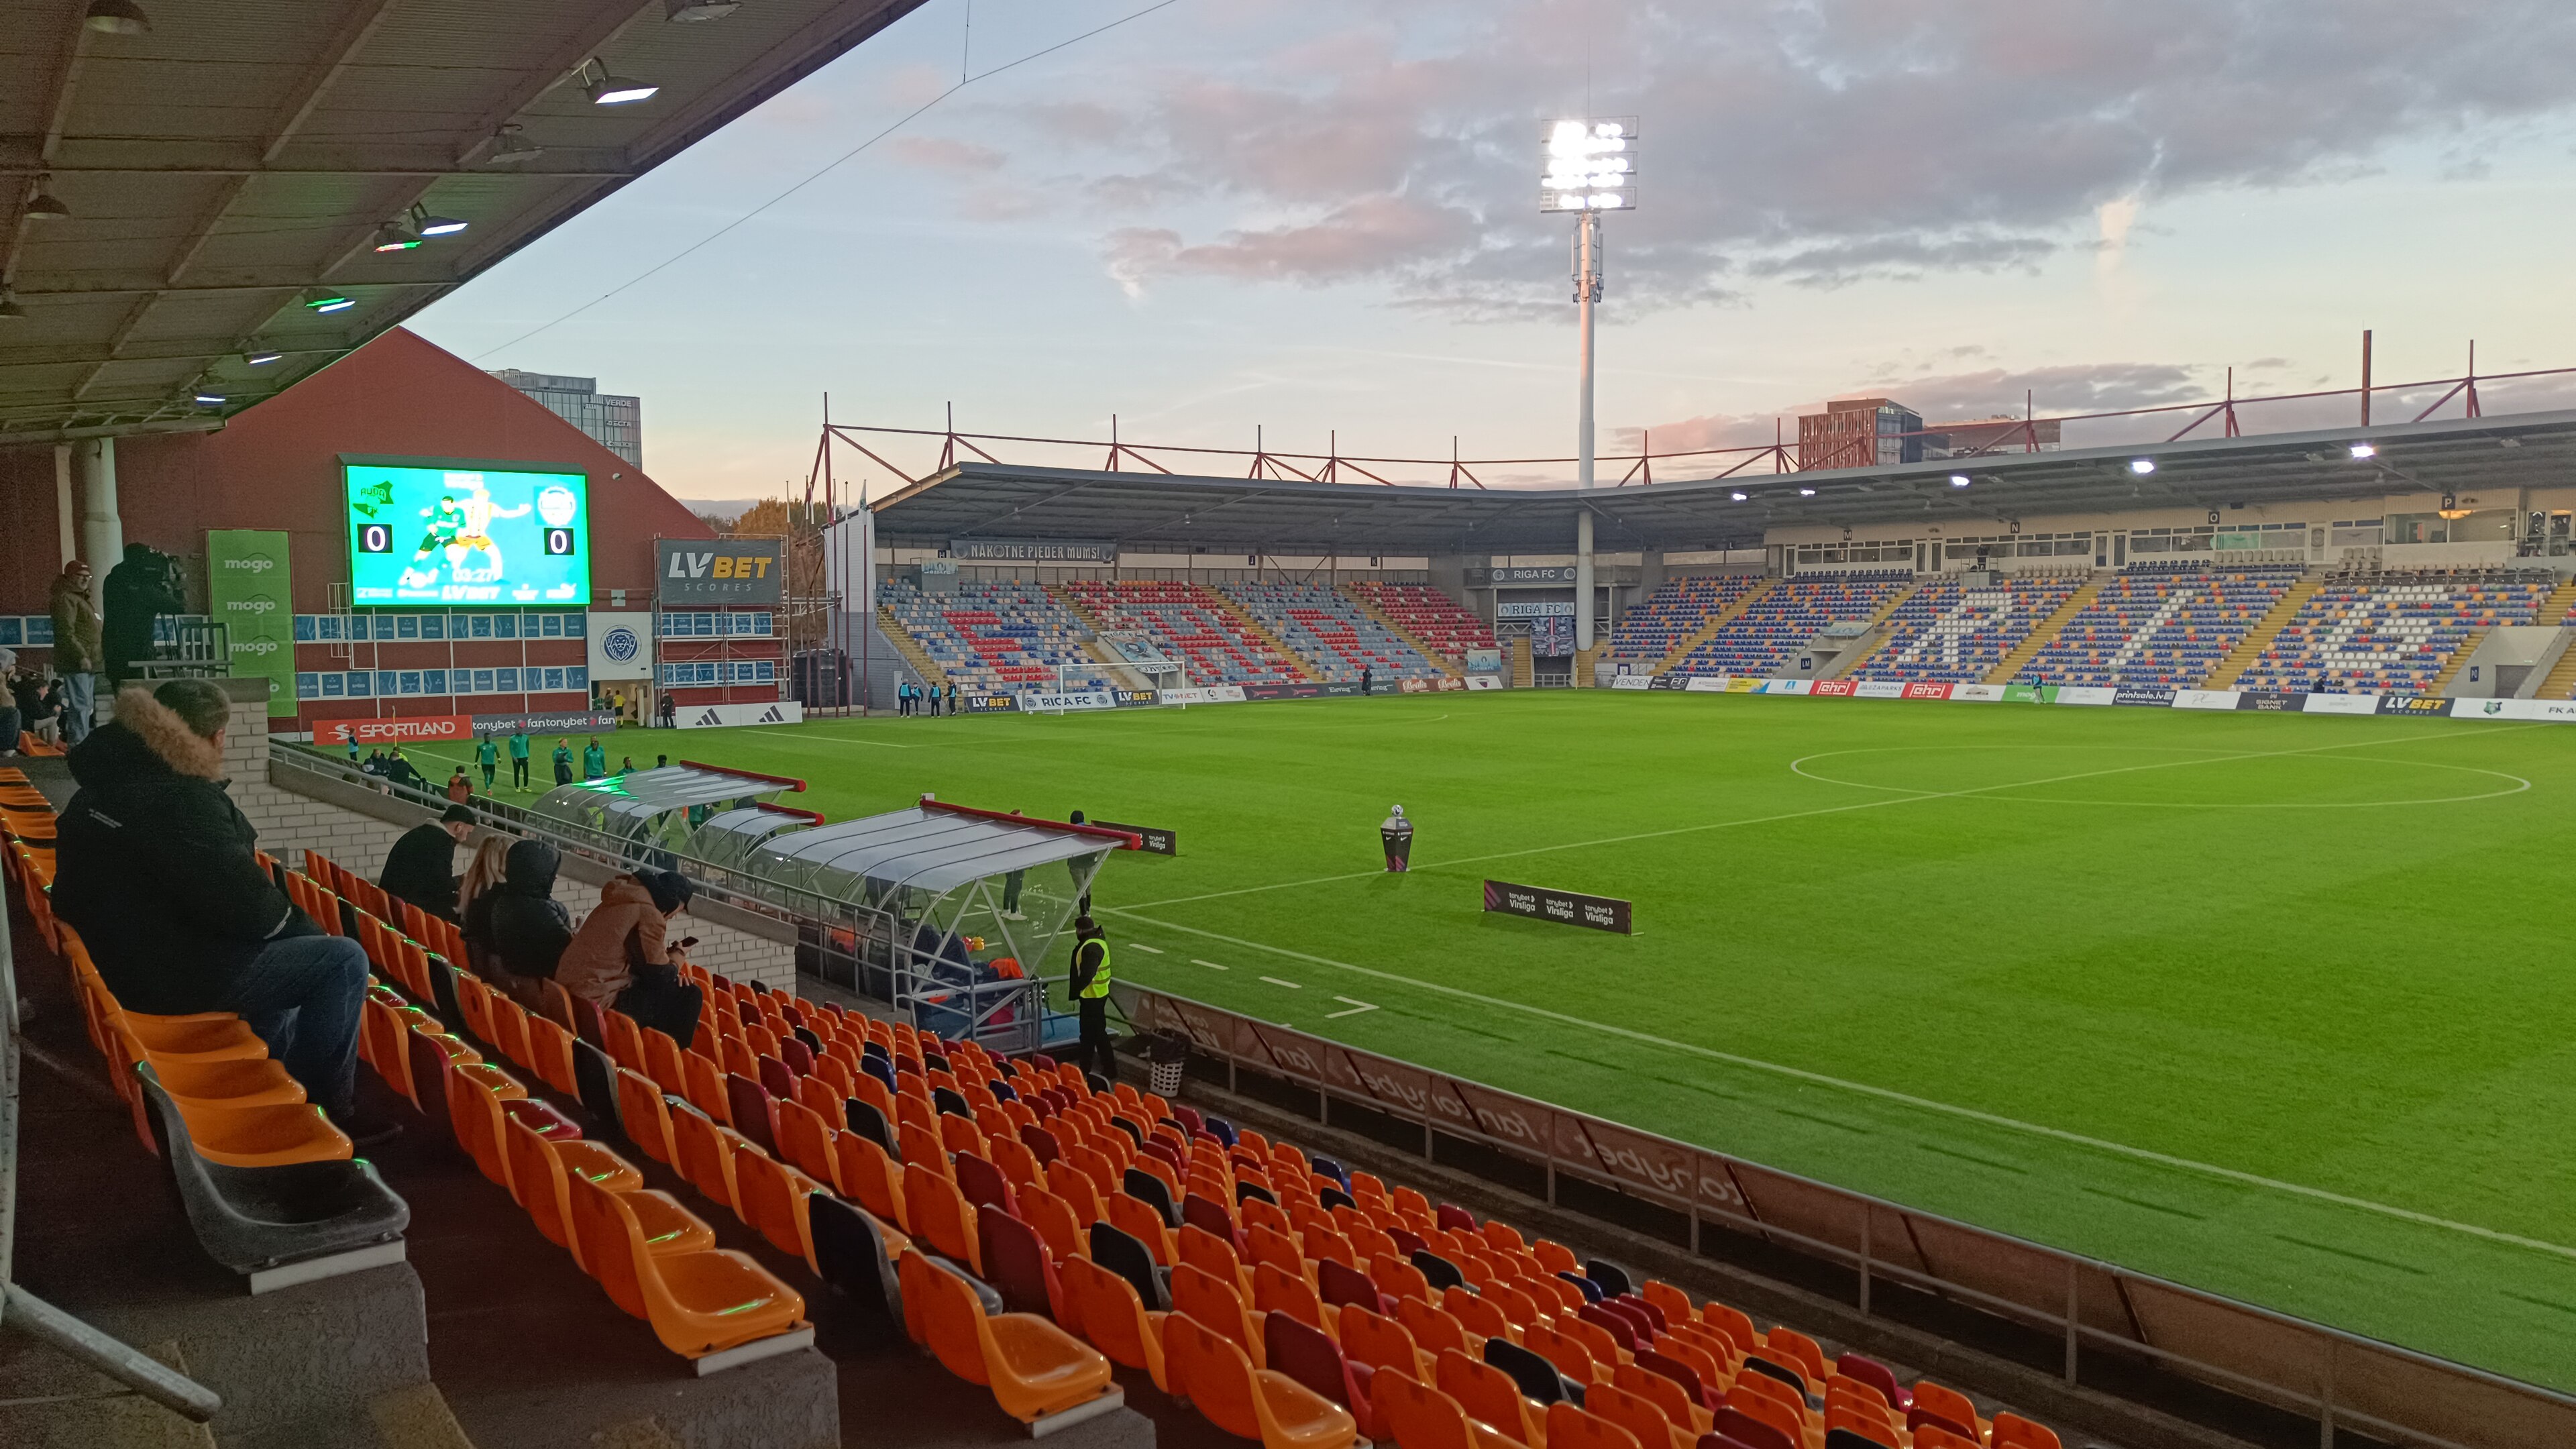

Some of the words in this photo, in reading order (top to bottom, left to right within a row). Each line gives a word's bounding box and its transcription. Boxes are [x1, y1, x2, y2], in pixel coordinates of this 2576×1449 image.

[606, 399, 632, 407] VERDE
[2445, 498, 2452, 507] P
[2210, 513, 2218, 522] O
[2012, 523, 2019, 532] N
[366, 527, 386, 551] 0
[550, 529, 568, 554] 0
[1028, 545, 1063, 559] PIEDER
[1067, 546, 1100, 559] MUMS!
[224, 559, 274, 573] mogo
[668, 552, 772, 578] LVBET
[1514, 570, 1539, 578] RIGA
[1542, 570, 1555, 578] FC
[684, 583, 751, 592] SCORES
[227, 600, 276, 614] mogo
[1512, 605, 1541, 614] RIGA
[1546, 604, 1560, 613] FC
[230, 642, 278, 655] mogo
[1615, 678, 1651, 686] VENDEN
[1075, 696, 1091, 705] FC
[1118, 692, 1152, 702] LVBET
[2017, 691, 2036, 700] mog
[2115, 690, 2164, 701] printsale.lv
[973, 697, 1011, 708] LVBET
[2385, 697, 2446, 710] LVBET
[472, 718, 515, 731] tonybet
[598, 715, 615, 724] fan
[360, 722, 455, 738] SPORTLAND
[1509, 892, 1530, 902] tonybet
[1509, 899, 1536, 912] Virsliga
[1546, 898, 1568, 908] tonybet
[1546, 906, 1573, 918] Virsliga
[1585, 904, 1608, 914] tonybet
[1585, 912, 1613, 925] Virsliga
